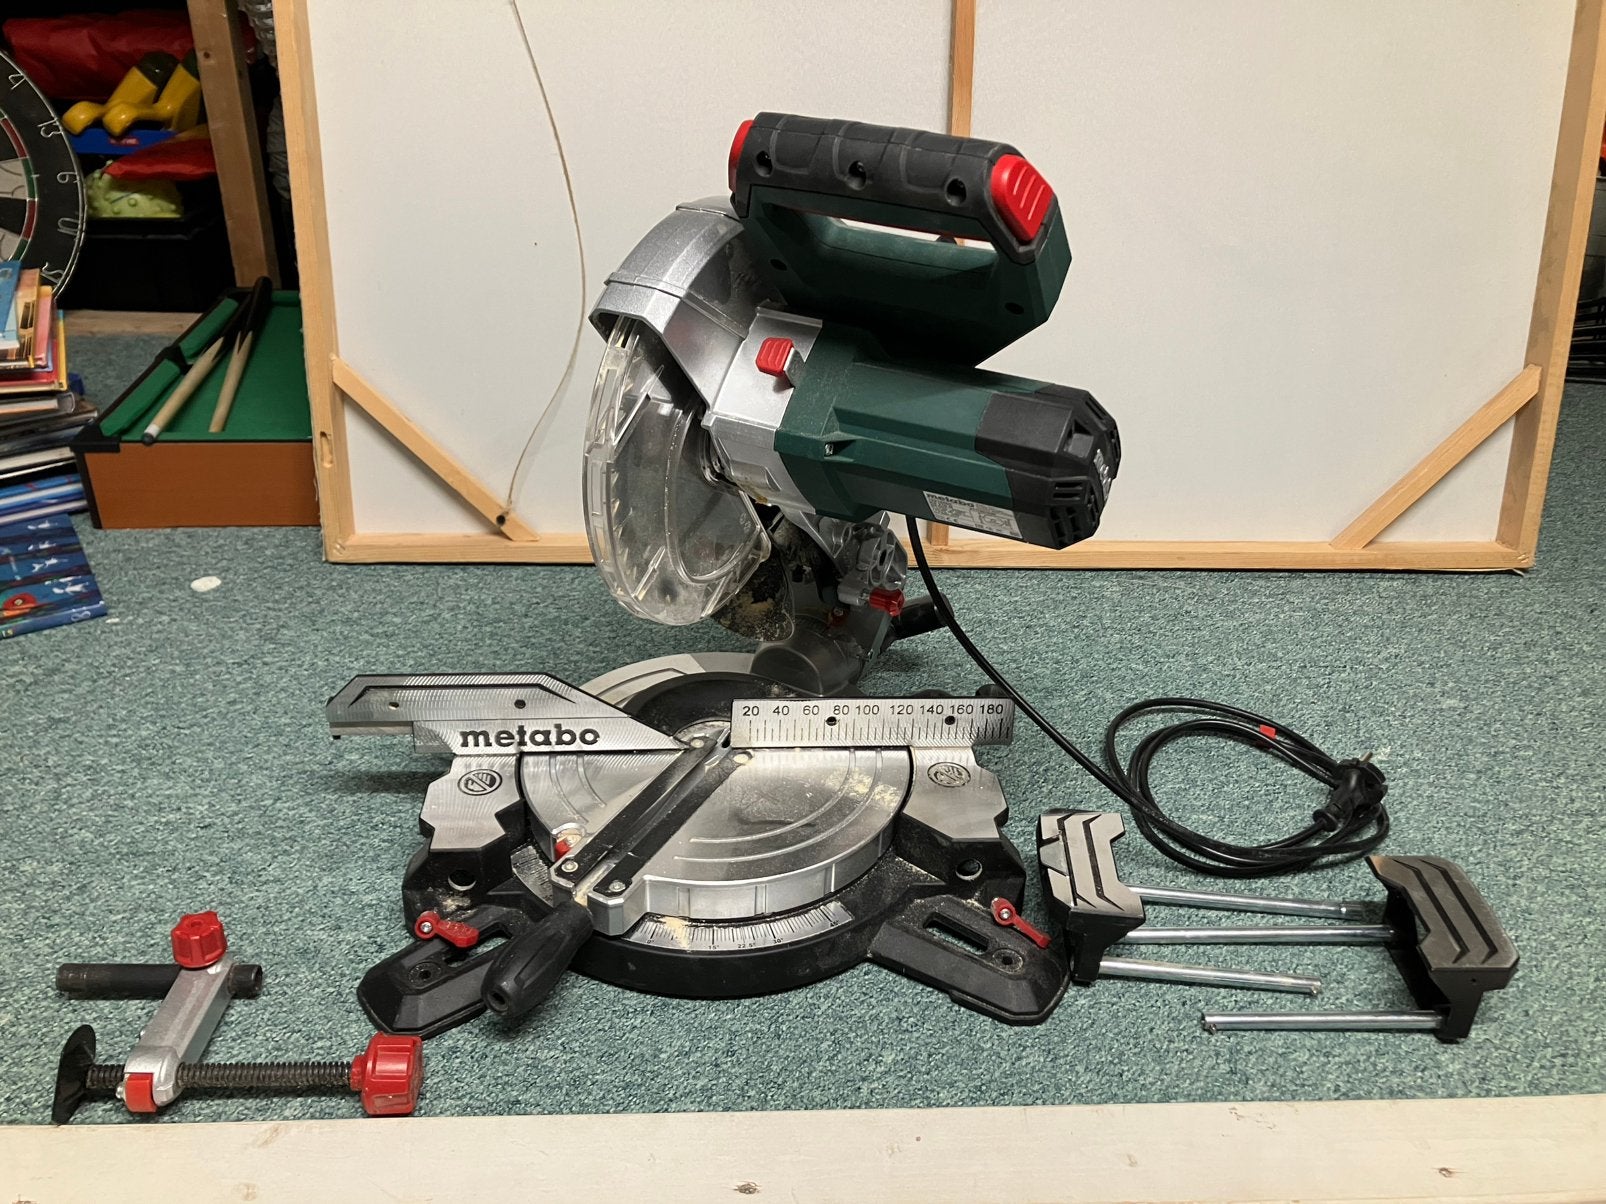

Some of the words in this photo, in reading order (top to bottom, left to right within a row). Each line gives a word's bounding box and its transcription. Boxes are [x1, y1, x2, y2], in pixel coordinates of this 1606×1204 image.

[37, 119, 63, 138] 13
[742, 705, 760, 716] 20
[772, 705, 790, 716] 40
[802, 704, 820, 716] 60
[833, 704, 850, 716] 80
[855, 704, 880, 716] 100
[889, 704, 914, 715] 120
[919, 704, 944, 715] 140
[949, 704, 974, 715] 160
[980, 703, 1004, 715] 180
[459, 723, 601, 748] metabo
